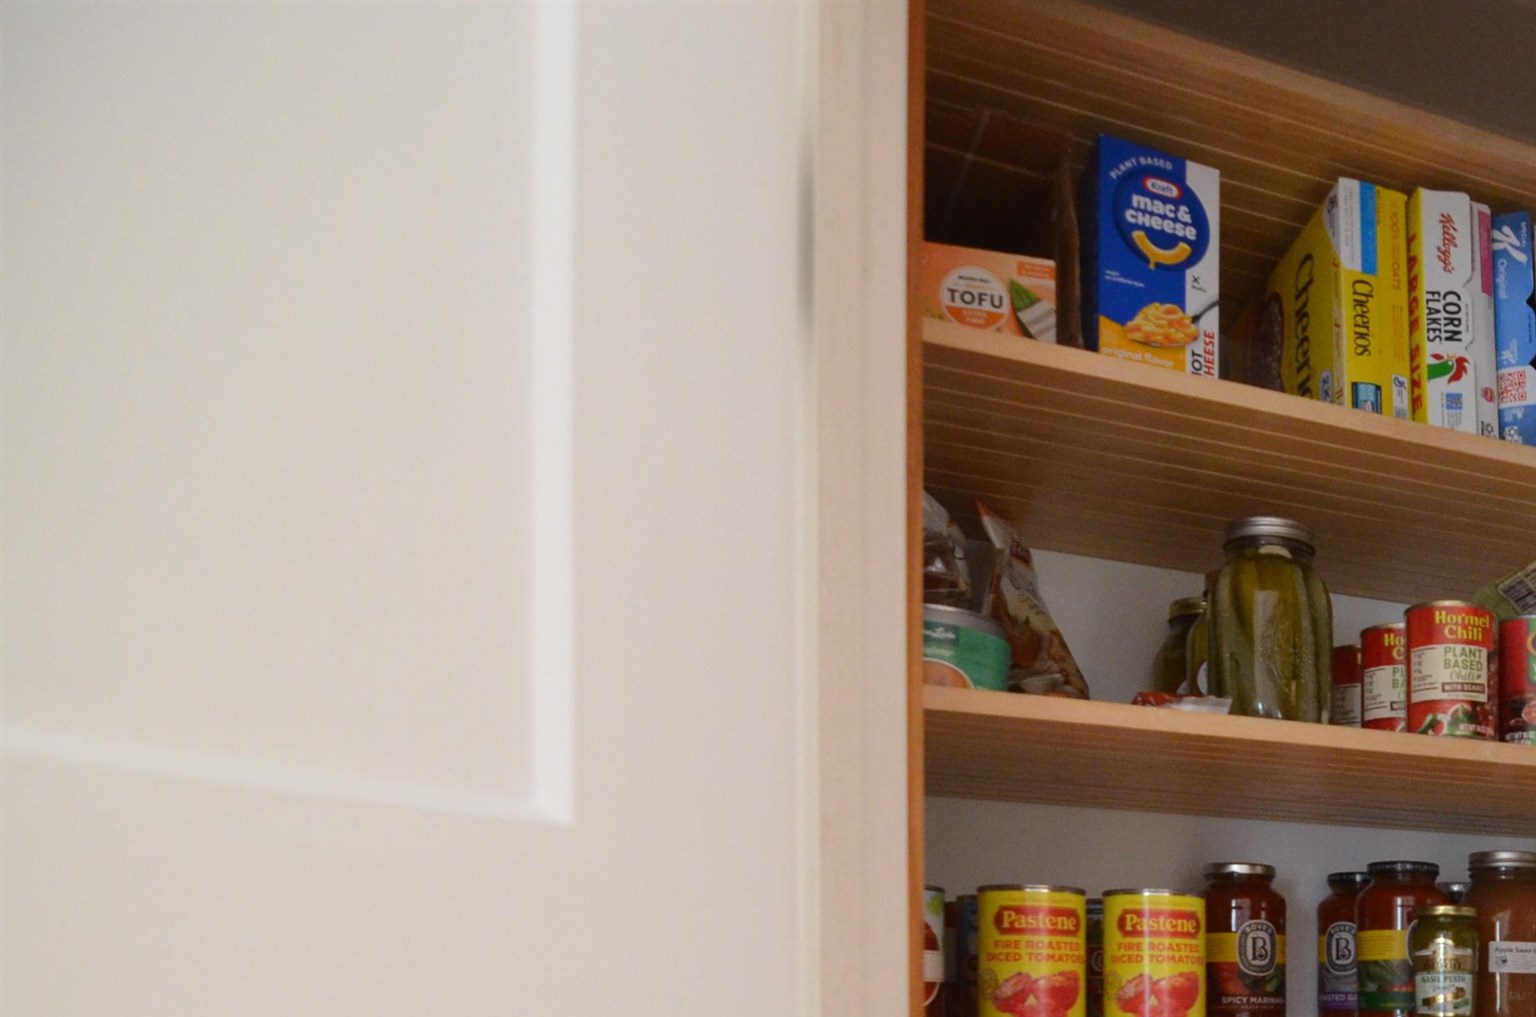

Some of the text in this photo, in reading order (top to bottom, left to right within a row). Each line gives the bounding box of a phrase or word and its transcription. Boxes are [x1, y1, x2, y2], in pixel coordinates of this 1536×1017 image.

[1109, 157, 1173, 181] PLANT BASED
[1132, 193, 1176, 219] mac
[947, 287, 1004, 311] TOFU
[1350, 278, 1374, 357] Cheerios
[1407, 236, 1424, 414] LARGE SIZE
[1426, 290, 1442, 344] FLAKES
[1442, 290, 1463, 343] CORN
[1434, 610, 1490, 629] Hormel
[1444, 624, 1483, 643] Chili
[1443, 646, 1483, 660] PLANT
[1443, 658, 1483, 673] BASED
[1001, 909, 1077, 931] Pastene
[1124, 911, 1197, 934] Pastene
[993, 939, 1081, 952] FIRE ROASTED
[1117, 941, 1200, 955] FIRE ROASTED
[1250, 935, 1269, 963] B
[986, 951, 1022, 964] DICED
[1110, 953, 1147, 966] DICED
